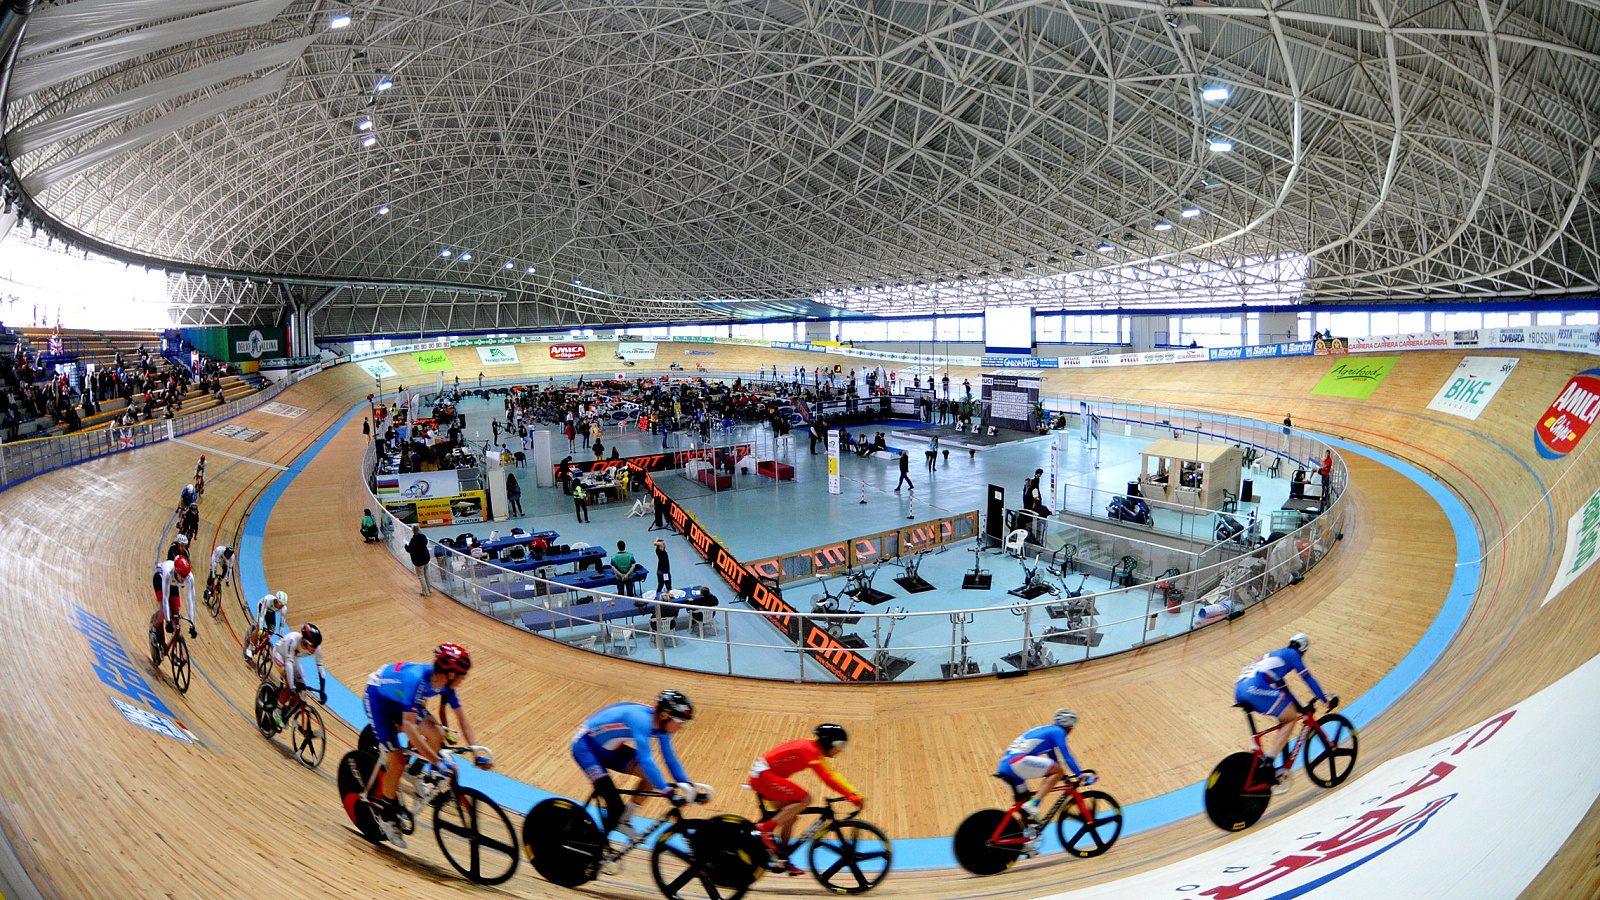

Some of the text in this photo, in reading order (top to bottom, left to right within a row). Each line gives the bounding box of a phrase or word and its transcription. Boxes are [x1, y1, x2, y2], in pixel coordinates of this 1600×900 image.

[551, 346, 584, 354] AMICA
[1253, 344, 1278, 355] Santini
[1289, 341, 1314, 353] Santini
[1532, 332, 1556, 344] BOSSINI
[1218, 347, 1242, 357] Santini
[1331, 364, 1384, 377] Agrifood
[1444, 377, 1492, 404] BIKE
[1552, 382, 1600, 424] AMICA
[669, 503, 689, 528] DMT
[690, 522, 714, 553] DMT
[716, 548, 749, 585] DMT
[752, 582, 800, 626] DMT
[806, 626, 874, 680] DMT
[1182, 710, 1518, 900] CARR
